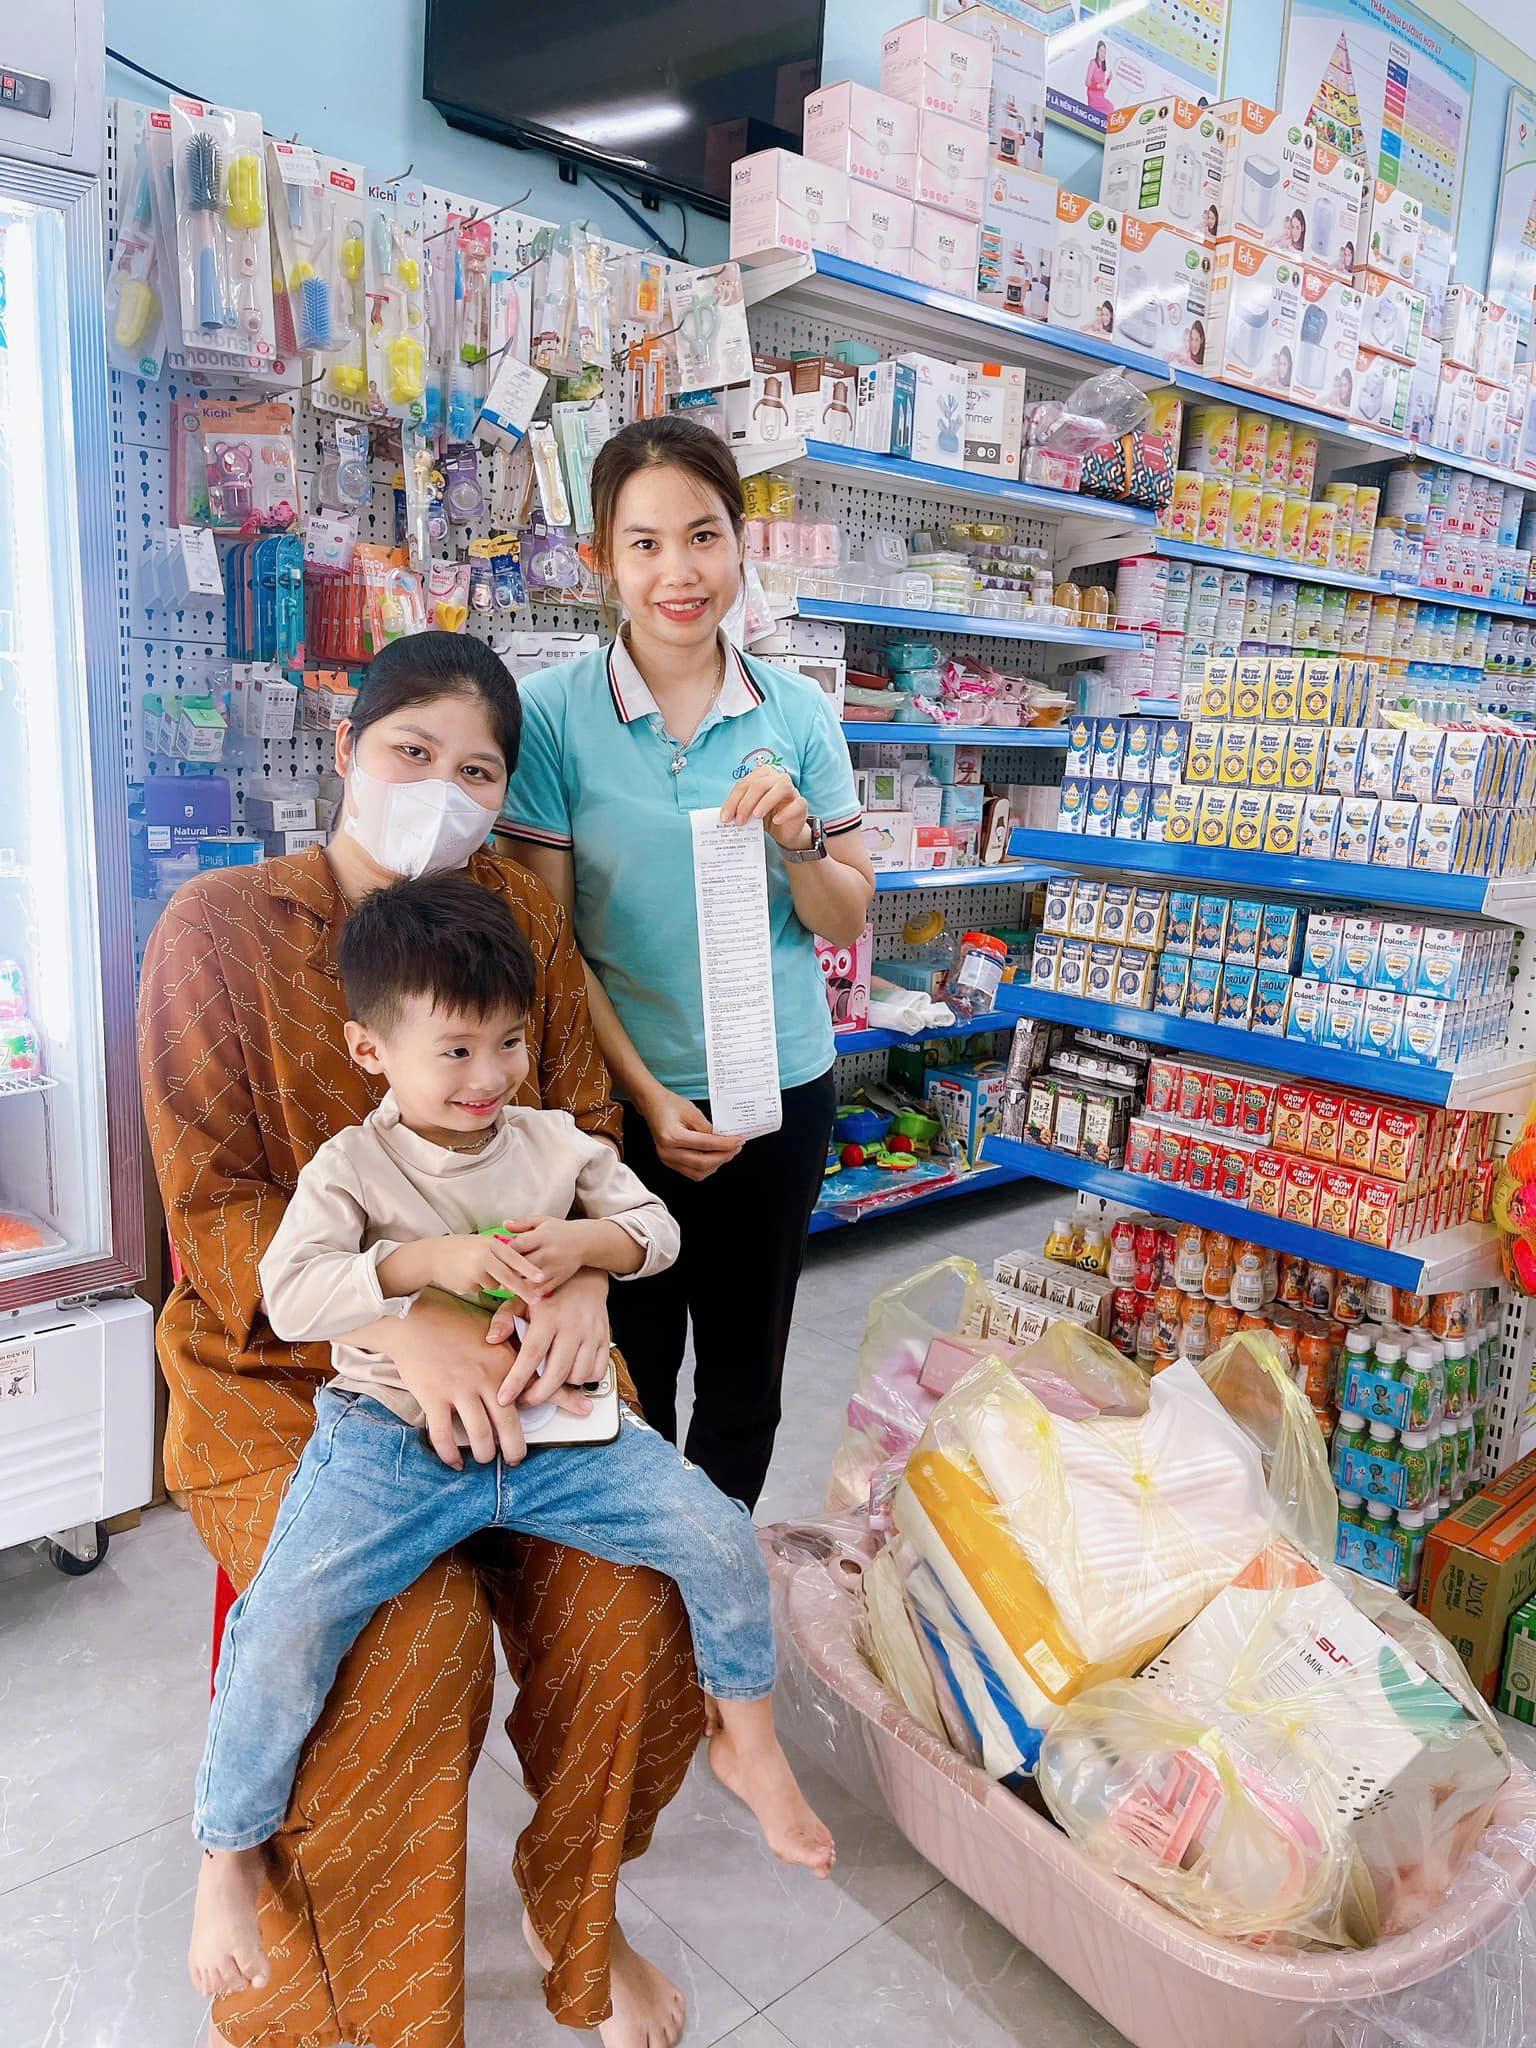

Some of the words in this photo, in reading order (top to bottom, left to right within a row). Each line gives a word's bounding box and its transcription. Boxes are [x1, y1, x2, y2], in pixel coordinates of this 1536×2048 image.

[950, 52, 968, 64] Kichi
[807, 101, 824, 115] Kichi
[876, 118, 894, 130] Kichi
[1086, 112, 1101, 126] CHO
[947, 143, 964, 155] Kichi
[735, 168, 751, 181] Kichi
[368, 187, 397, 202] Kichi
[805, 186, 824, 199] Kichi
[872, 212, 889, 225] Kichi
[938, 236, 956, 248] Kichi
[202, 407, 231, 418] Kichi
[965, 413, 993, 424] mmer
[311, 522, 329, 531] Kichi
[174, 827, 208, 836] Natural
[1283, 1093, 1305, 1104] GROW
[1286, 1101, 1301, 1109] PLUS
[1316, 1101, 1338, 1112] GROW
[1318, 1108, 1334, 1117] PLUS
[1350, 1109, 1372, 1120] GROW
[1352, 1117, 1368, 1126] PLUS
[1386, 1118, 1409, 1130] GROW
[1389, 1127, 1405, 1136] PLUS
[1259, 1160, 1280, 1171] GROW
[1262, 1168, 1276, 1177] PLUS
[1292, 1169, 1315, 1180] GROW
[1296, 1177, 1311, 1186] PLUS
[1328, 1178, 1352, 1190] GROW
[1331, 1186, 1347, 1196] PLUS
[1366, 1188, 1391, 1200] GROW
[1370, 1196, 1386, 1207] PLUS
[996, 1273, 1013, 1286] Nut
[1022, 1282, 1040, 1295] Nut
[1050, 1291, 1067, 1304] Nut
[1077, 1300, 1096, 1314] Nut
[1021, 1321, 1041, 1334] Nut
[1304, 1653, 1326, 1677] Milk
